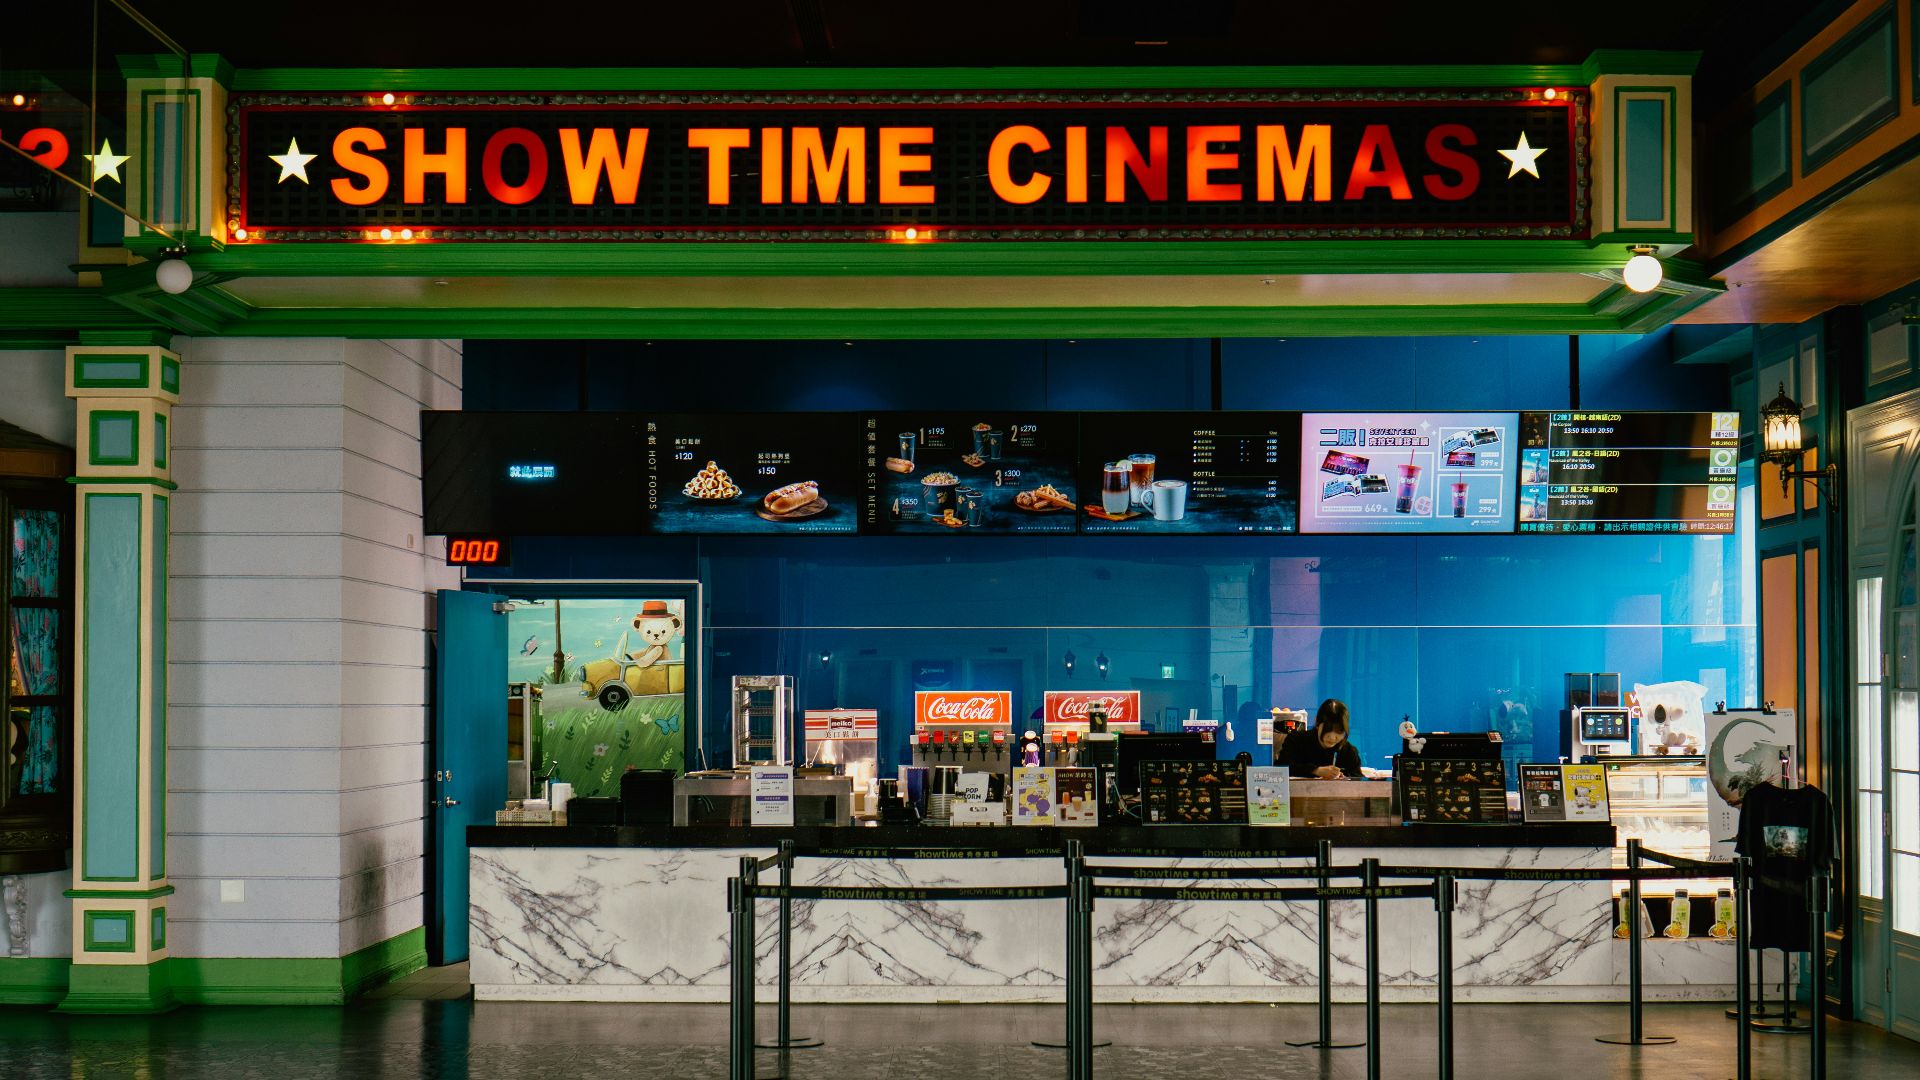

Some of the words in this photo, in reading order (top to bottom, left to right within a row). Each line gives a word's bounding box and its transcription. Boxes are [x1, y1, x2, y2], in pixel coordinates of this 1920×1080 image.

[331, 126, 650, 206] SHOW
[687, 126, 936, 206] TIME
[987, 123, 1477, 205] CINEMAS
[928, 427, 945, 437] $195
[1011, 425, 1018, 442] 2
[1020, 424, 1037, 432] $270
[1369, 428, 1417, 436] SEVENTEEN
[920, 427, 925, 445] 1
[648, 450, 657, 471] HOT
[675, 452, 694, 460] $120
[758, 466, 776, 475] $150
[1004, 469, 1021, 478] $300
[867, 472, 876, 490] SET
[996, 469, 1002, 487] 3
[648, 475, 657, 509] FOODS
[892, 498, 899, 515] 4
[901, 498, 918, 506] $350
[867, 494, 876, 523] MENU
[450, 540, 499, 562] 000
[927, 696, 1000, 720] Coca-Cola
[914, 850, 964, 859] showtime
[1202, 849, 1252, 858] showtime
[1134, 868, 1189, 878] showtime
[1503, 870, 1561, 880] showtime
[821, 887, 884, 899] showtime
[959, 888, 1003, 896] SHOWTIME
[1176, 888, 1239, 900] showtime
[1315, 888, 1361, 896] SHOWTIME
